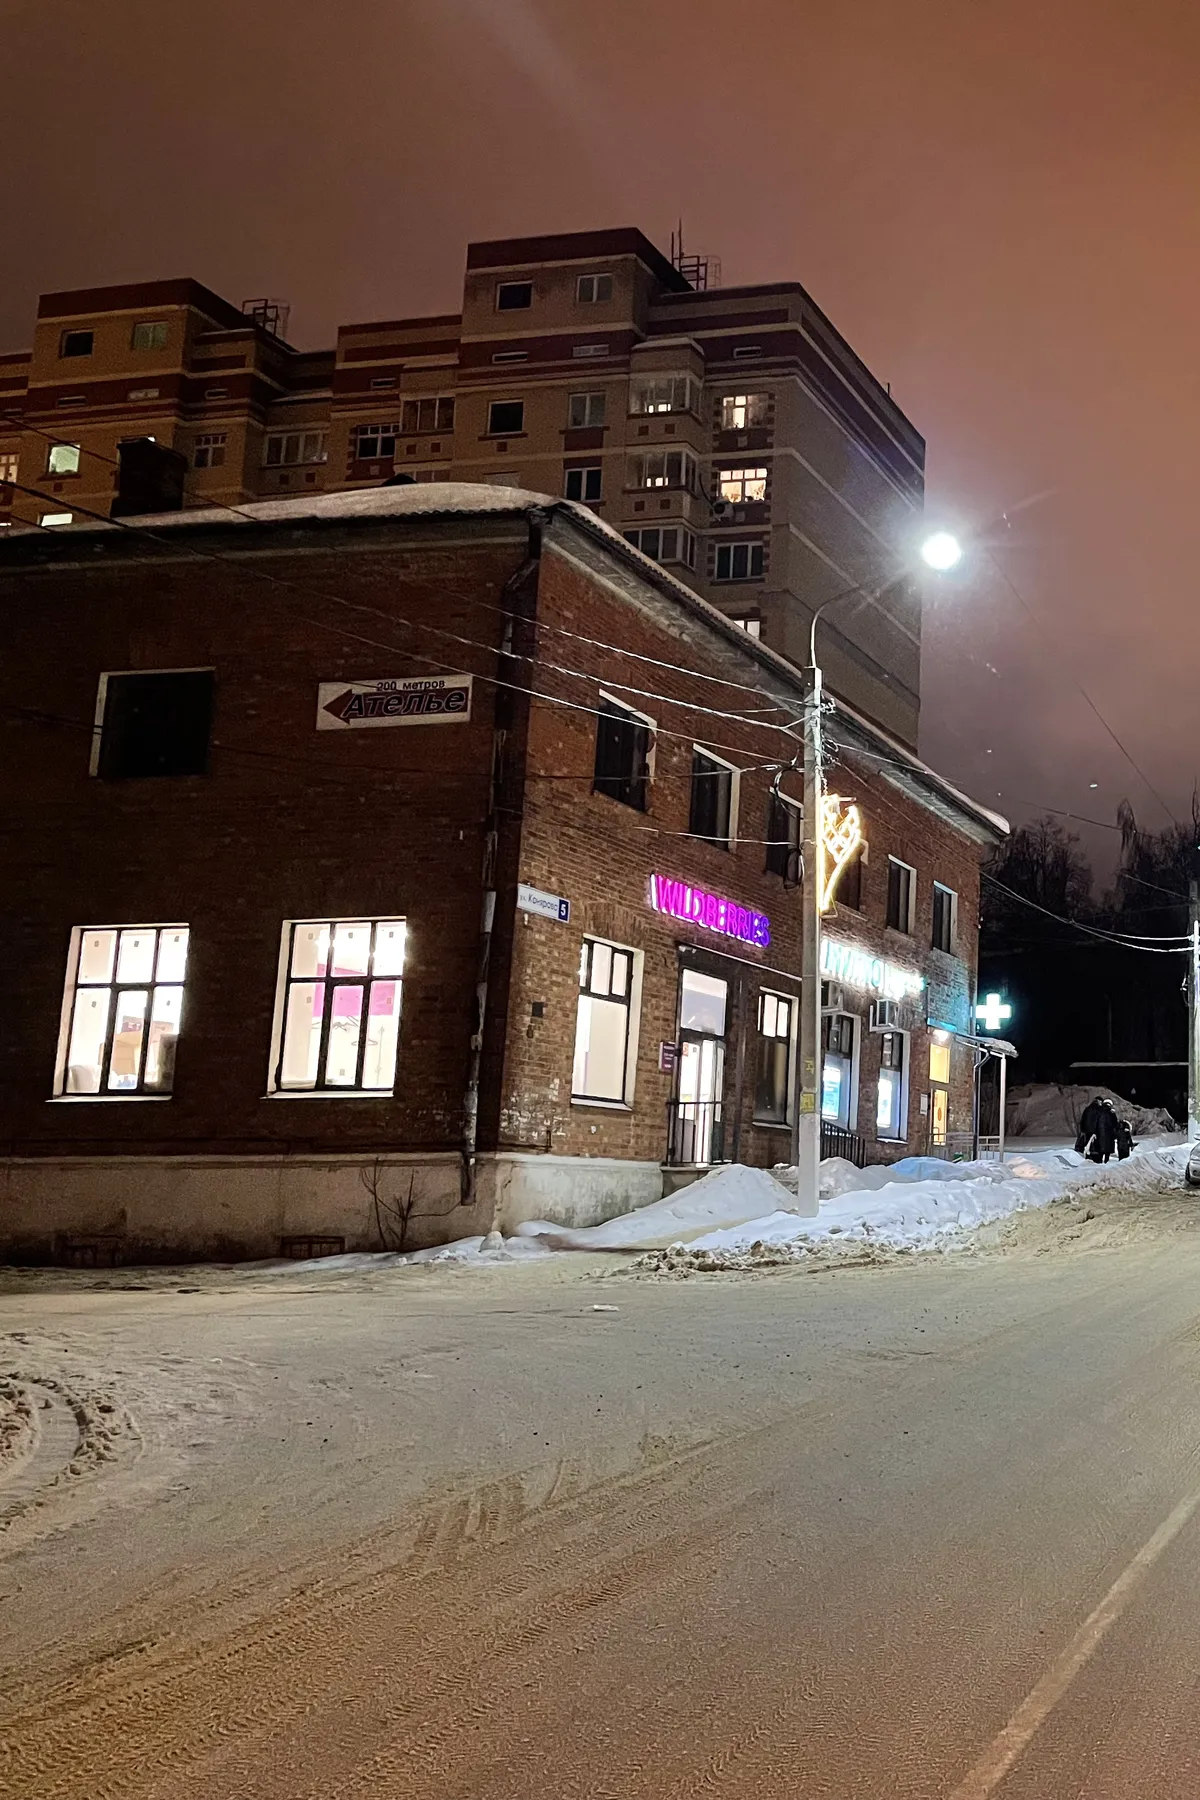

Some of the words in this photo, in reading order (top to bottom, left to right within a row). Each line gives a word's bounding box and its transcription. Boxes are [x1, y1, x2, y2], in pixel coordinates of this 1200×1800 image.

[377, 681, 397, 692] 200
[402, 679, 446, 692] метров
[340, 690, 466, 718] Ателье
[560, 903, 567, 917] 5
[651, 873, 771, 948] WILDBERRIES
